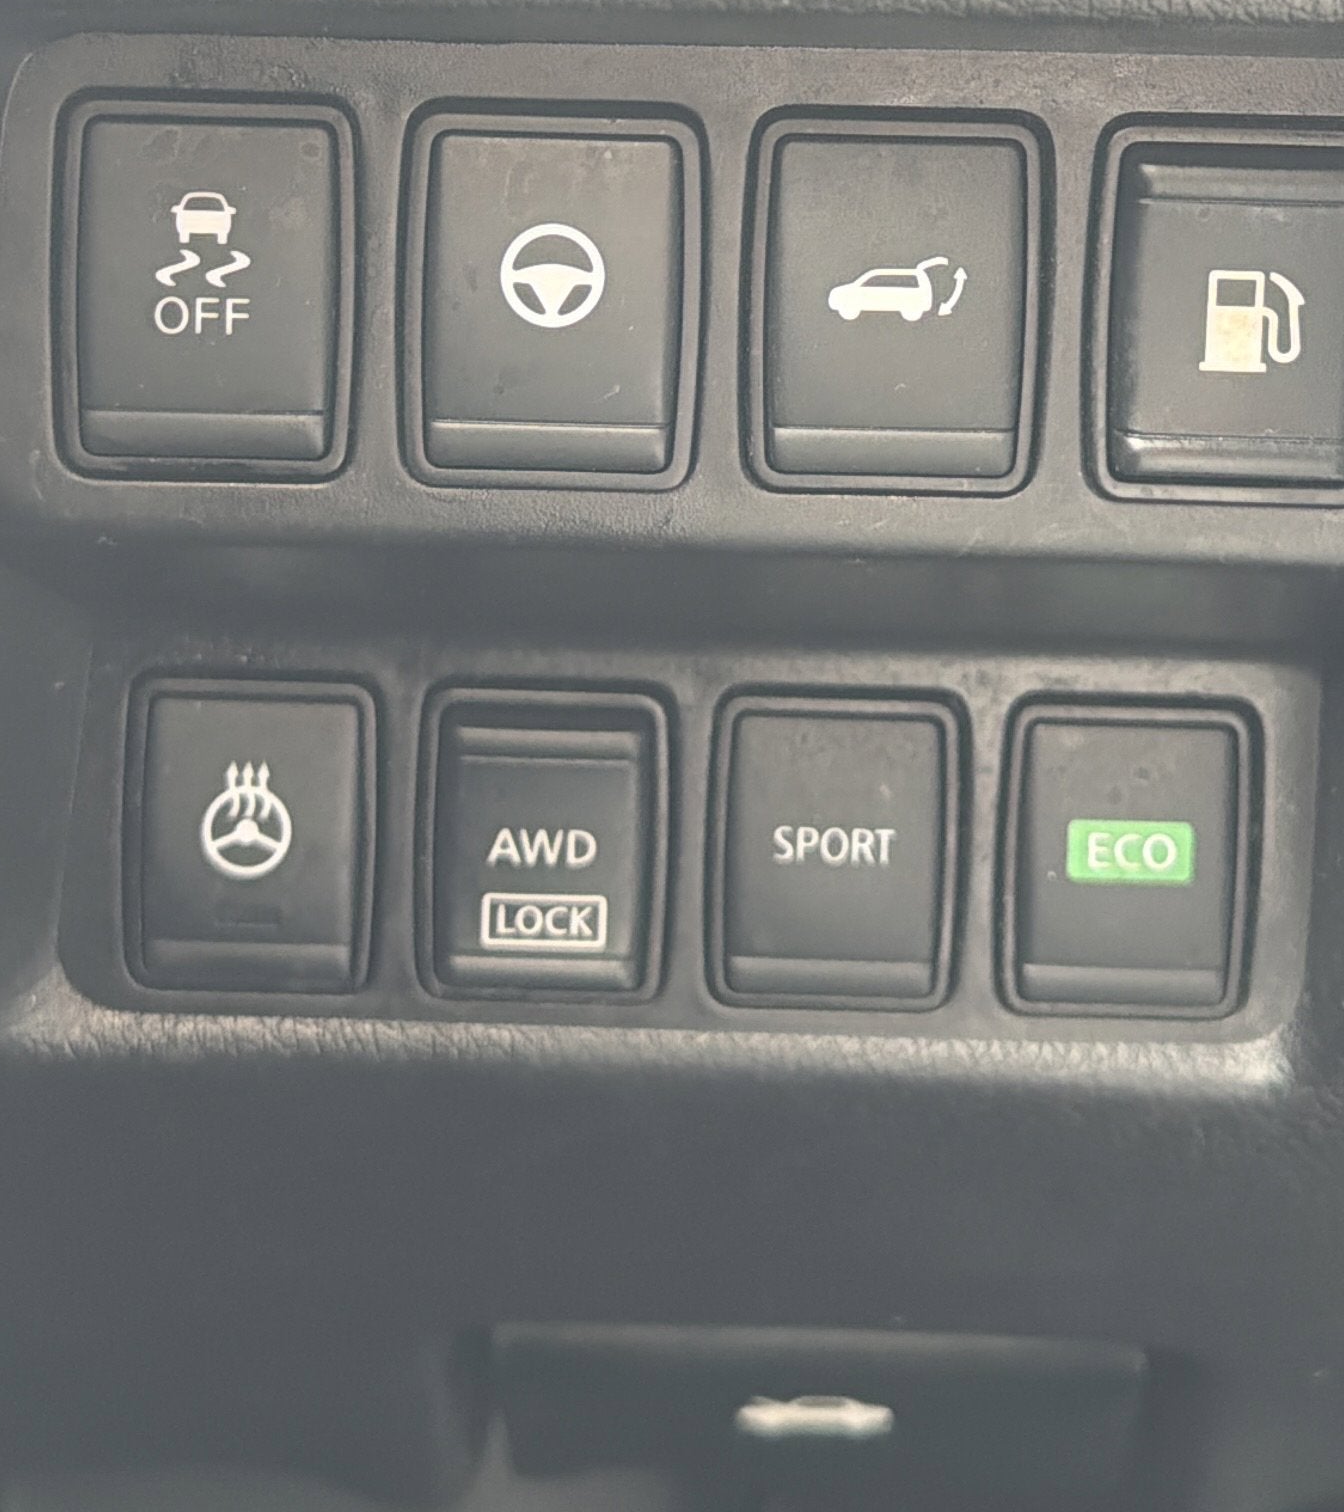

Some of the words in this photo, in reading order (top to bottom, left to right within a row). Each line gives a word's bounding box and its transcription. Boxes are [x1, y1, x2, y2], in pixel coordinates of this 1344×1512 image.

[154, 296, 251, 335] OFF
[487, 828, 598, 867] AWD
[773, 825, 896, 864] SPORT
[1087, 832, 1179, 871] ECO
[494, 903, 594, 937] LOCK
